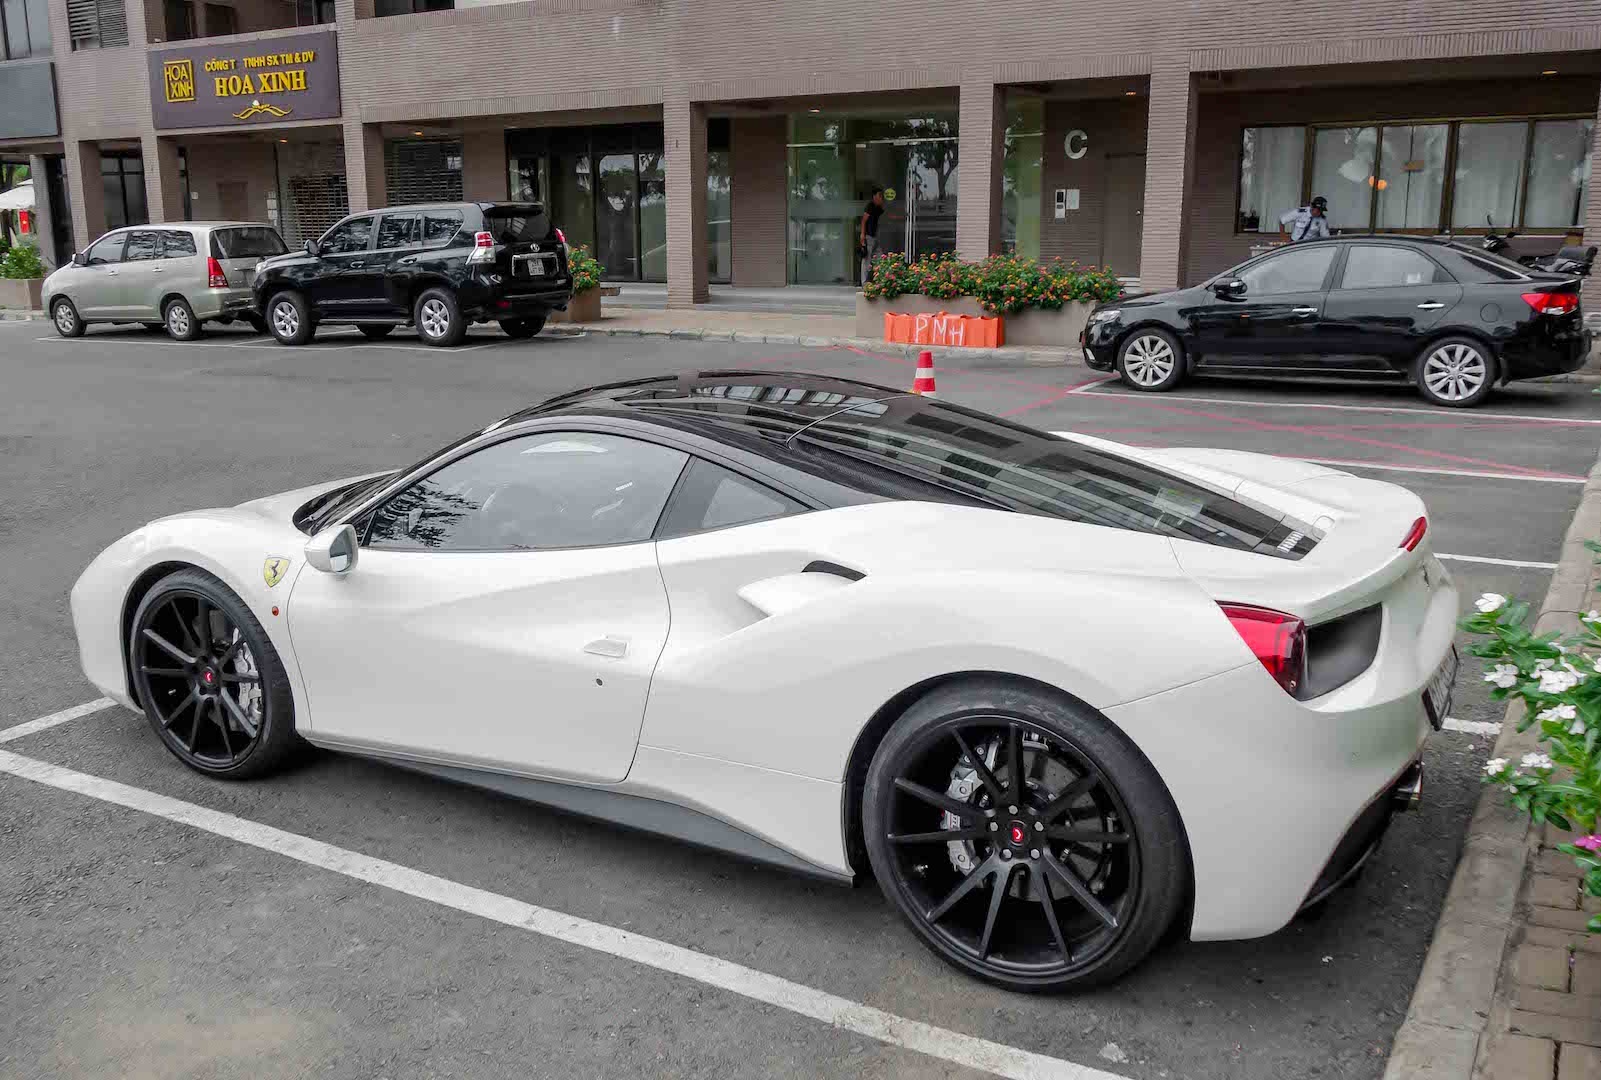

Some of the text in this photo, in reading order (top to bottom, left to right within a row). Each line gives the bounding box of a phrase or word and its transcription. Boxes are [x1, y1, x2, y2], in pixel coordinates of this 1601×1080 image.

[164, 64, 189, 81] HOA
[205, 58, 229, 72] CÔNG
[243, 56, 266, 69] TNHH
[267, 55, 280, 66] SX
[281, 53, 293, 65] TM
[294, 52, 301, 63] &
[301, 51, 315, 63] DV
[170, 81, 194, 98] XINH
[215, 69, 307, 97] HOA XINH
[1064, 129, 1088, 160] C
[914, 316, 965, 347] PMH
